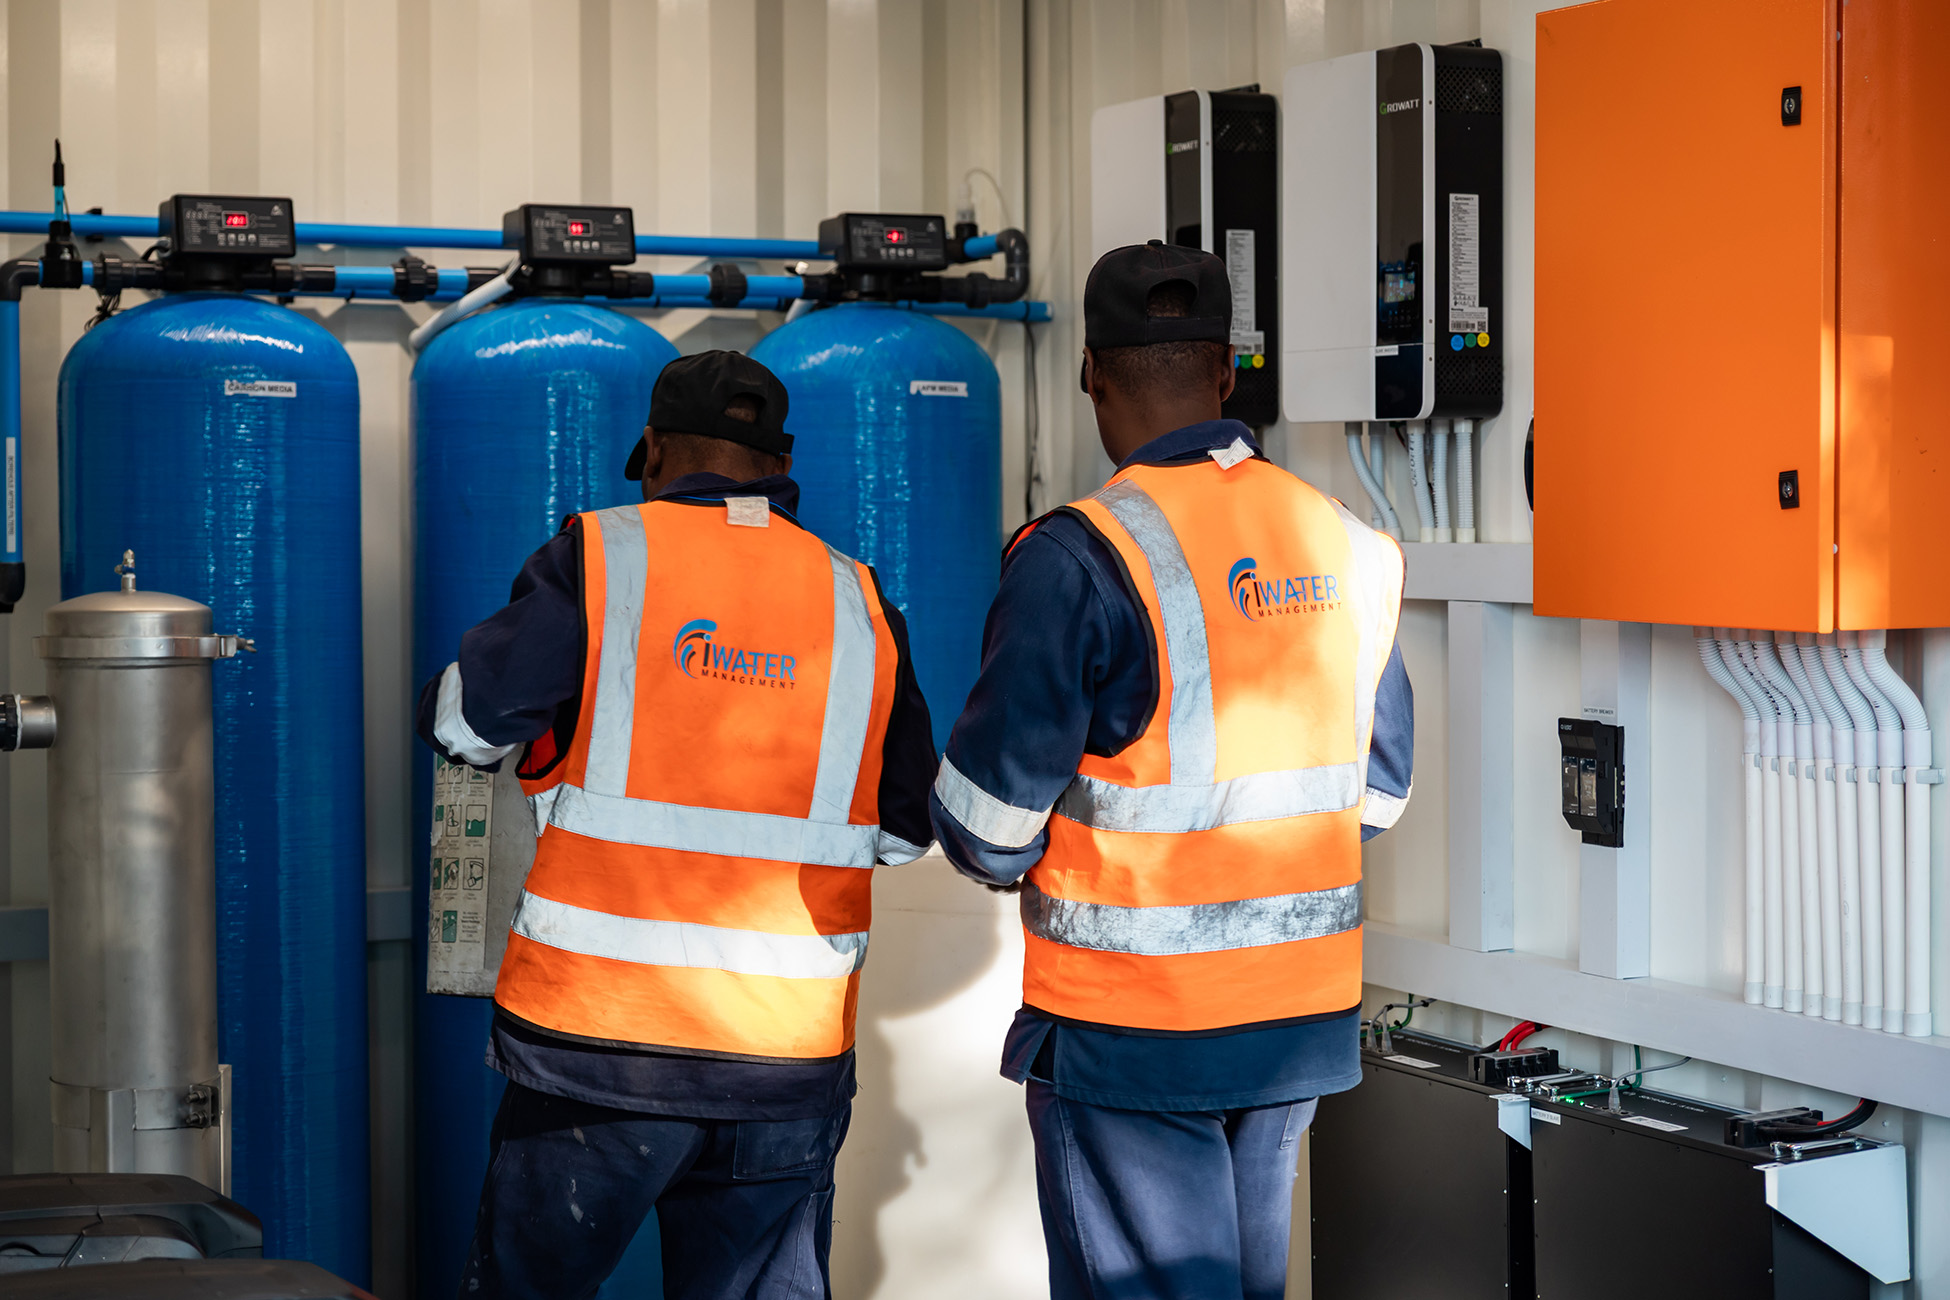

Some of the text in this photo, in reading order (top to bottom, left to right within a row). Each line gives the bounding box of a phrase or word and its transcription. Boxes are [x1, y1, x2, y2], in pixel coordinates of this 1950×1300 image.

[1379, 98, 1420, 115] GROWATT
[267, 385, 293, 393] MEDIA
[1258, 602, 1341, 618] MANAGEMENT
[701, 668, 796, 690] MANAGEMENT
